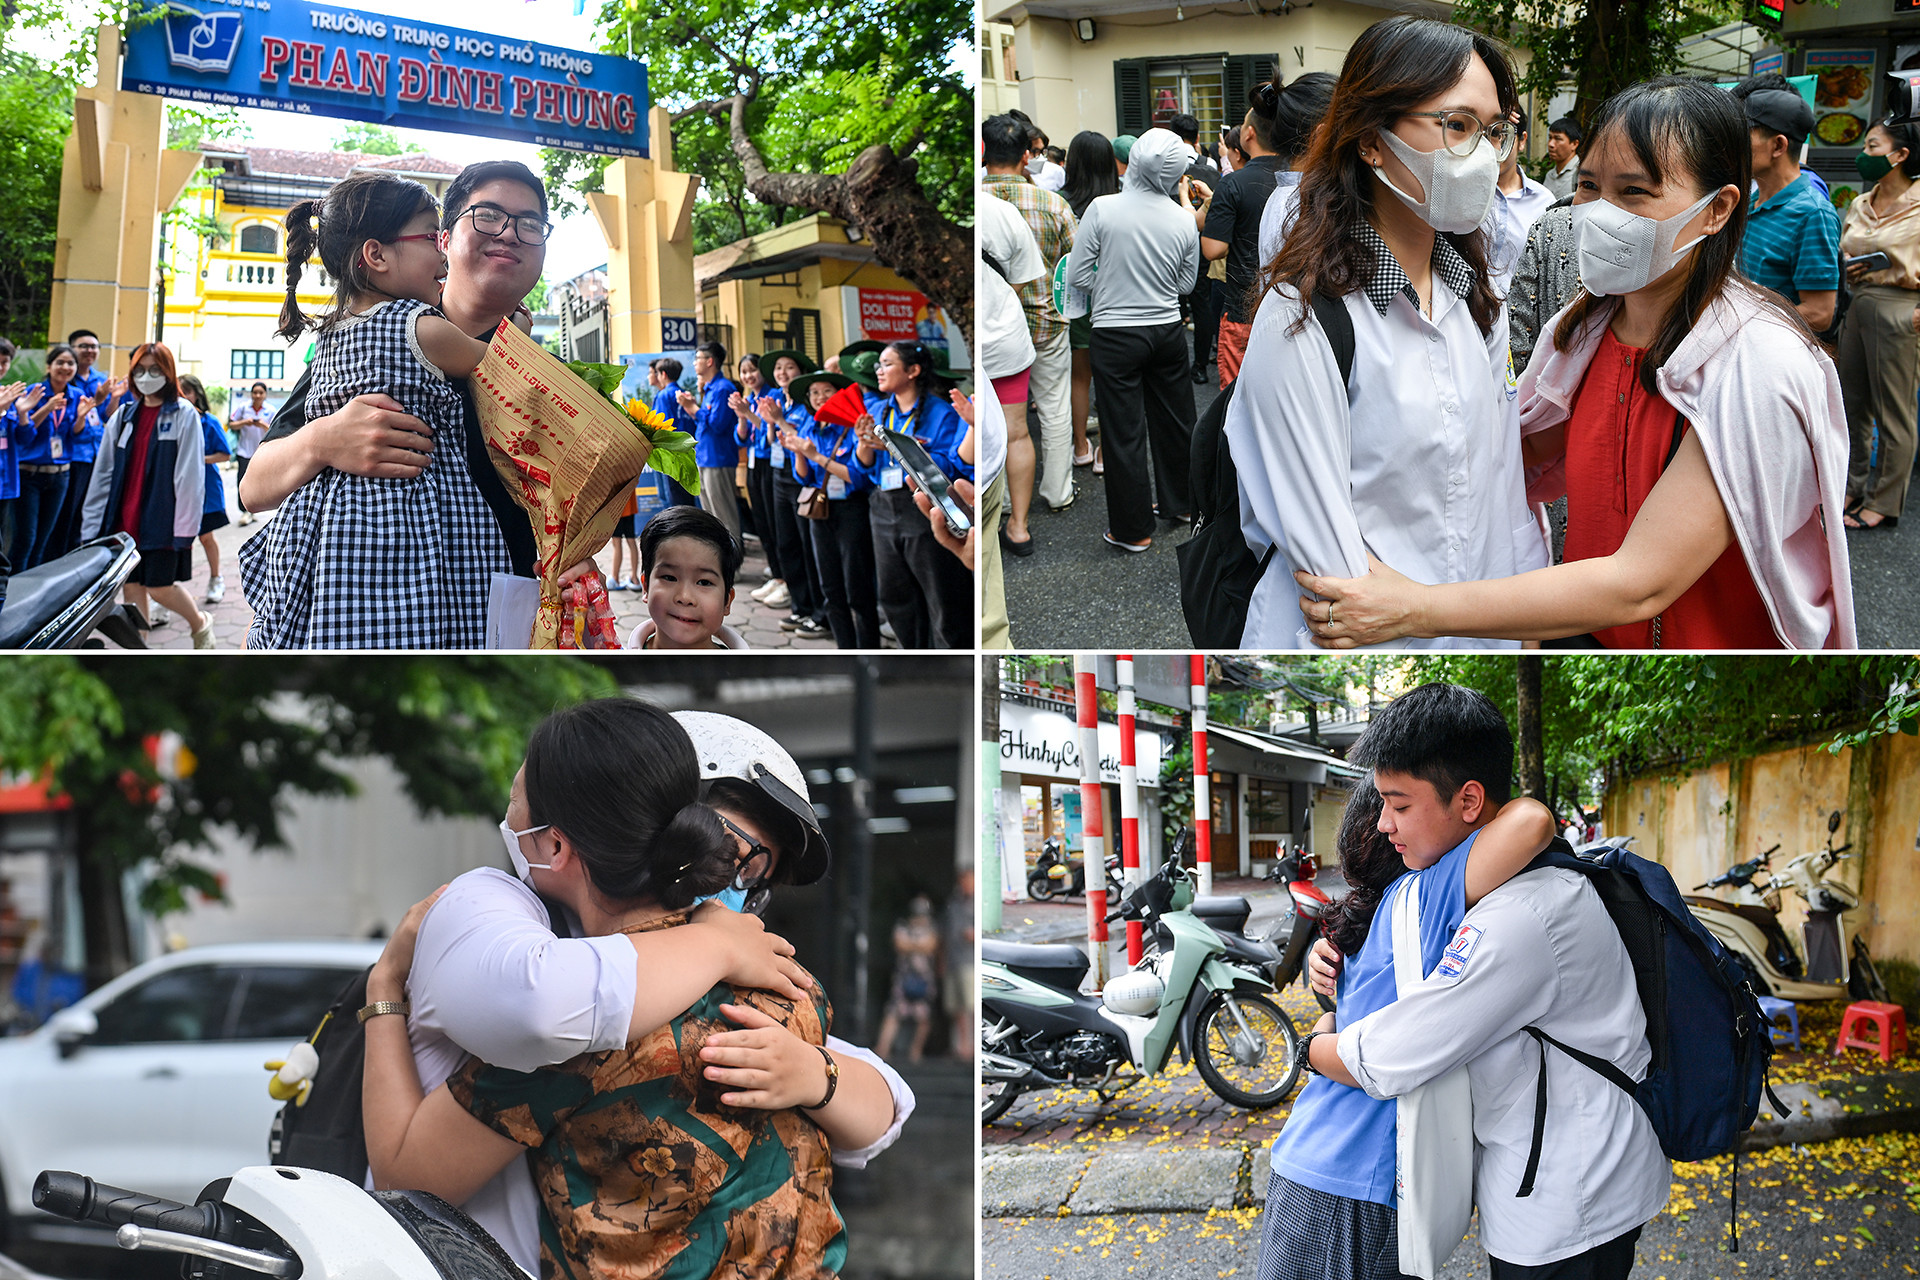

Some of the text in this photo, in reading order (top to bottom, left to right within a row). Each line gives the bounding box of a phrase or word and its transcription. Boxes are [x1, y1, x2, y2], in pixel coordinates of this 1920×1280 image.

[310, 10, 593, 75] TRƯỜNG TRUNG HỌC PHỔ THÔNG
[259, 35, 637, 134] PHAN ĐÌNH PHÙNG
[156, 86, 166, 95] 30
[168, 87, 191, 98] PHAN
[192, 89, 212, 101] ĐÌNH
[247, 97, 258, 107] BA
[260, 98, 279, 109] ĐÌNH
[284, 100, 295, 111] HÀ
[862, 303, 913, 318] DOL IELTS
[664, 320, 695, 342] 30
[864, 316, 913, 334] ĐÌNH LỰC
[490, 341, 508, 359] HOW
[506, 356, 520, 371] DO
[523, 371, 551, 395] LOVE
[550, 393, 579, 419] THEE
